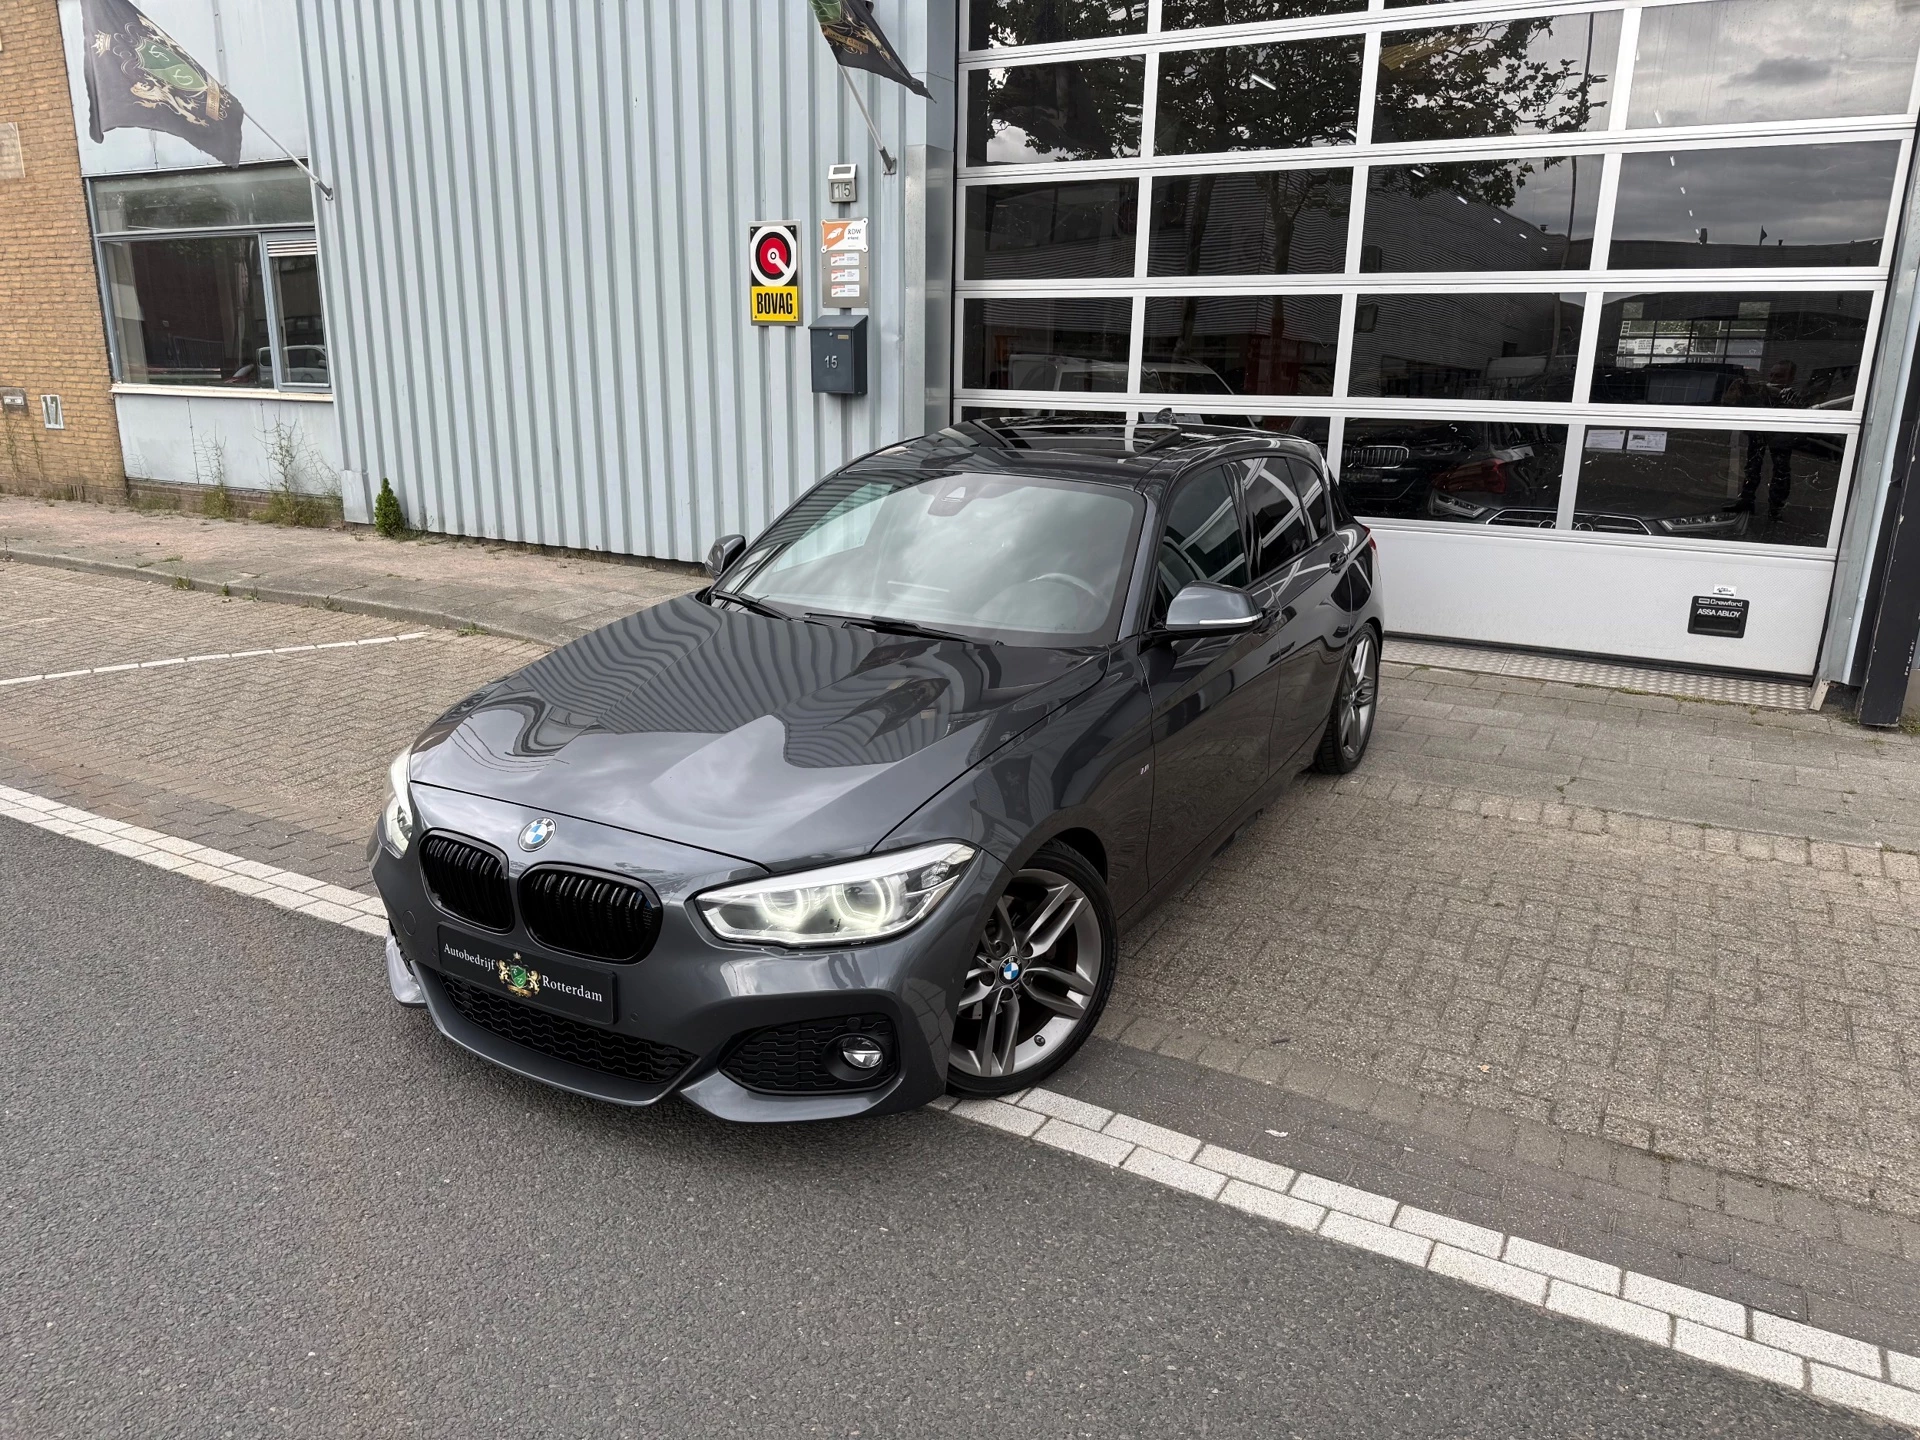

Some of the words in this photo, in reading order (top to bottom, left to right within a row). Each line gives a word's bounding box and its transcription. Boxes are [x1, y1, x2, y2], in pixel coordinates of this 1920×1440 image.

[835, 183, 851, 198] 15
[756, 292, 793, 315] BOVAG
[824, 355, 838, 369] 15
[1710, 599, 1743, 608] Crawford
[1697, 608, 1716, 616] ASSA
[1717, 610, 1741, 618] ABLOY
[443, 943, 496, 973] Autobedrijf
[542, 974, 603, 1002] Rotterdam
